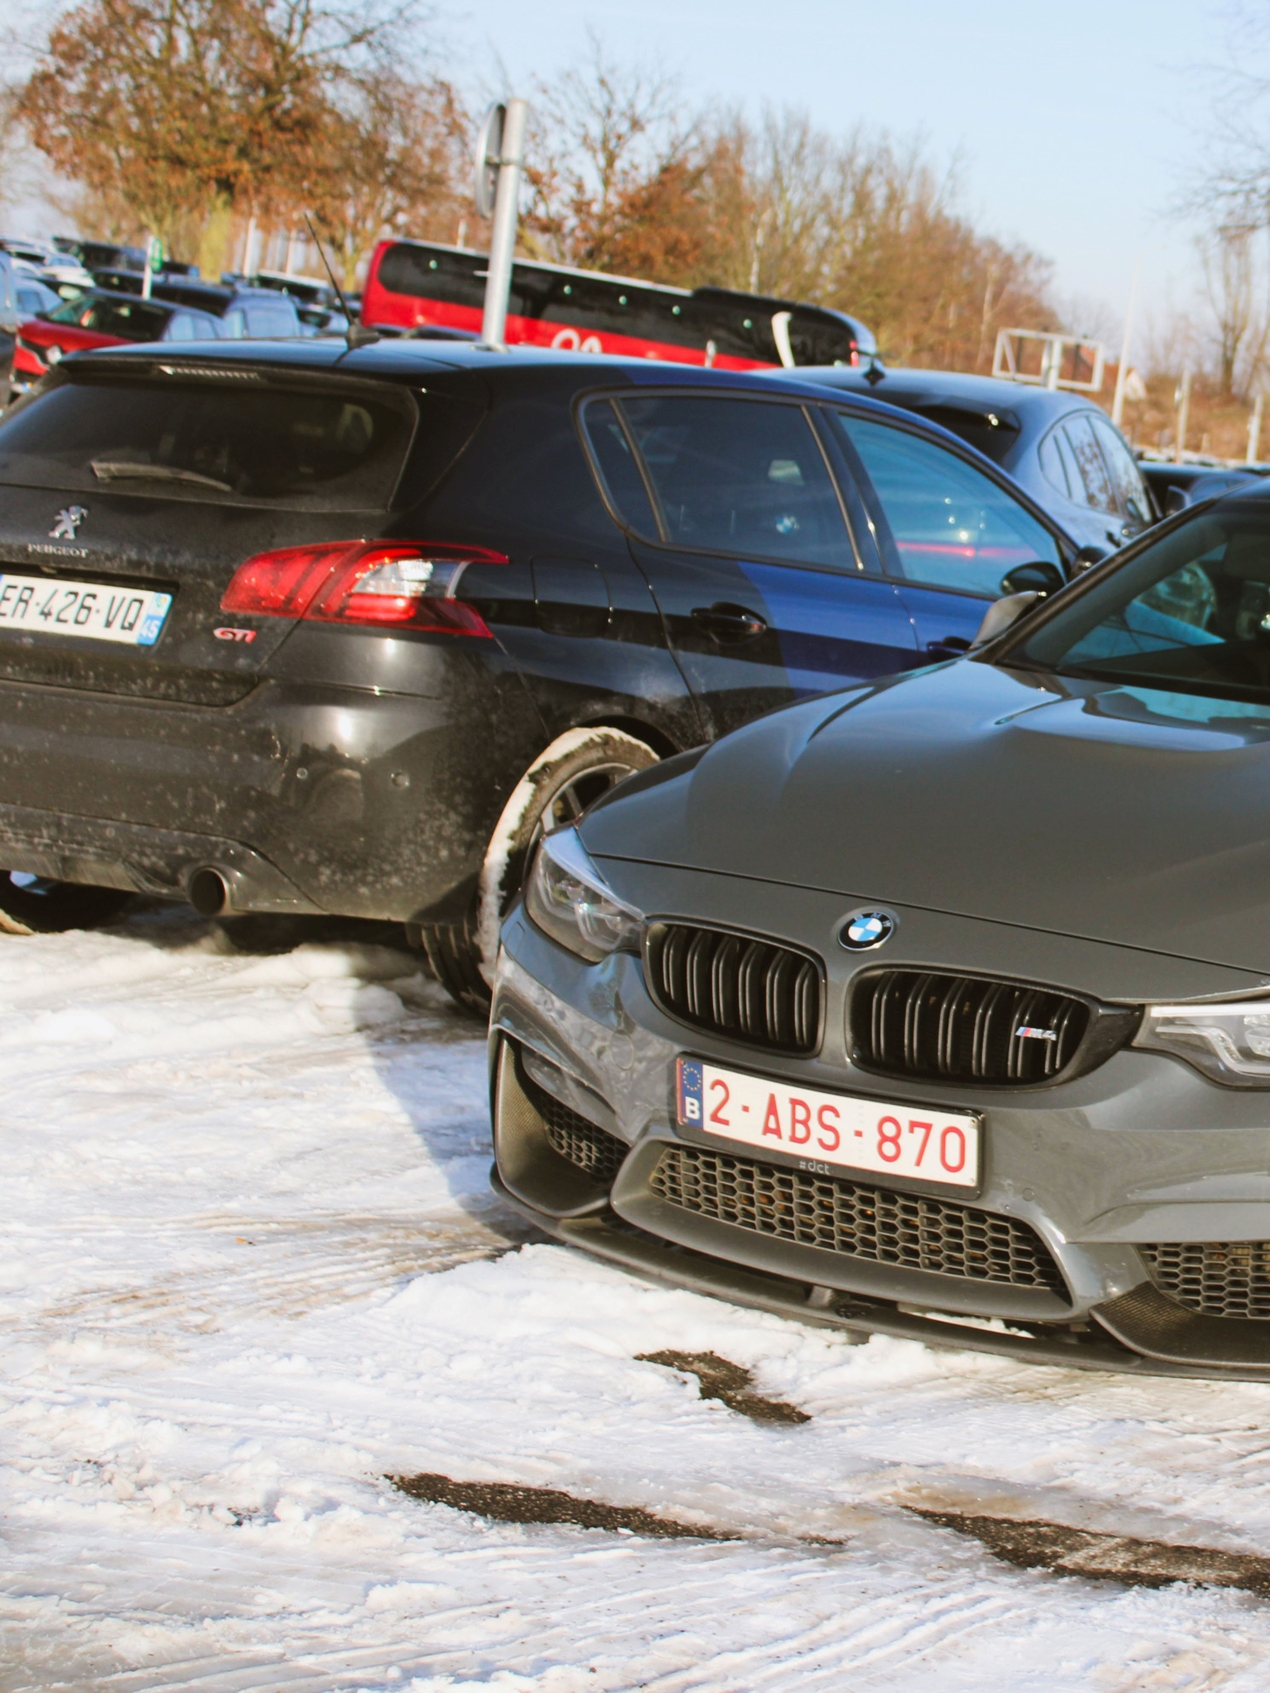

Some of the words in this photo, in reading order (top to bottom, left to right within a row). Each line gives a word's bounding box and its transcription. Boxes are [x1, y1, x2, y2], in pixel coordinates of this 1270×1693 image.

[28, 543, 89, 558] PEUGEOT
[140, 619, 160, 638] 45
[1029, 1027, 1057, 1041] M4
[685, 1096, 701, 1120] B
[709, 1078, 966, 1174] 2-ABS-870
[799, 1160, 830, 1175] #dct
